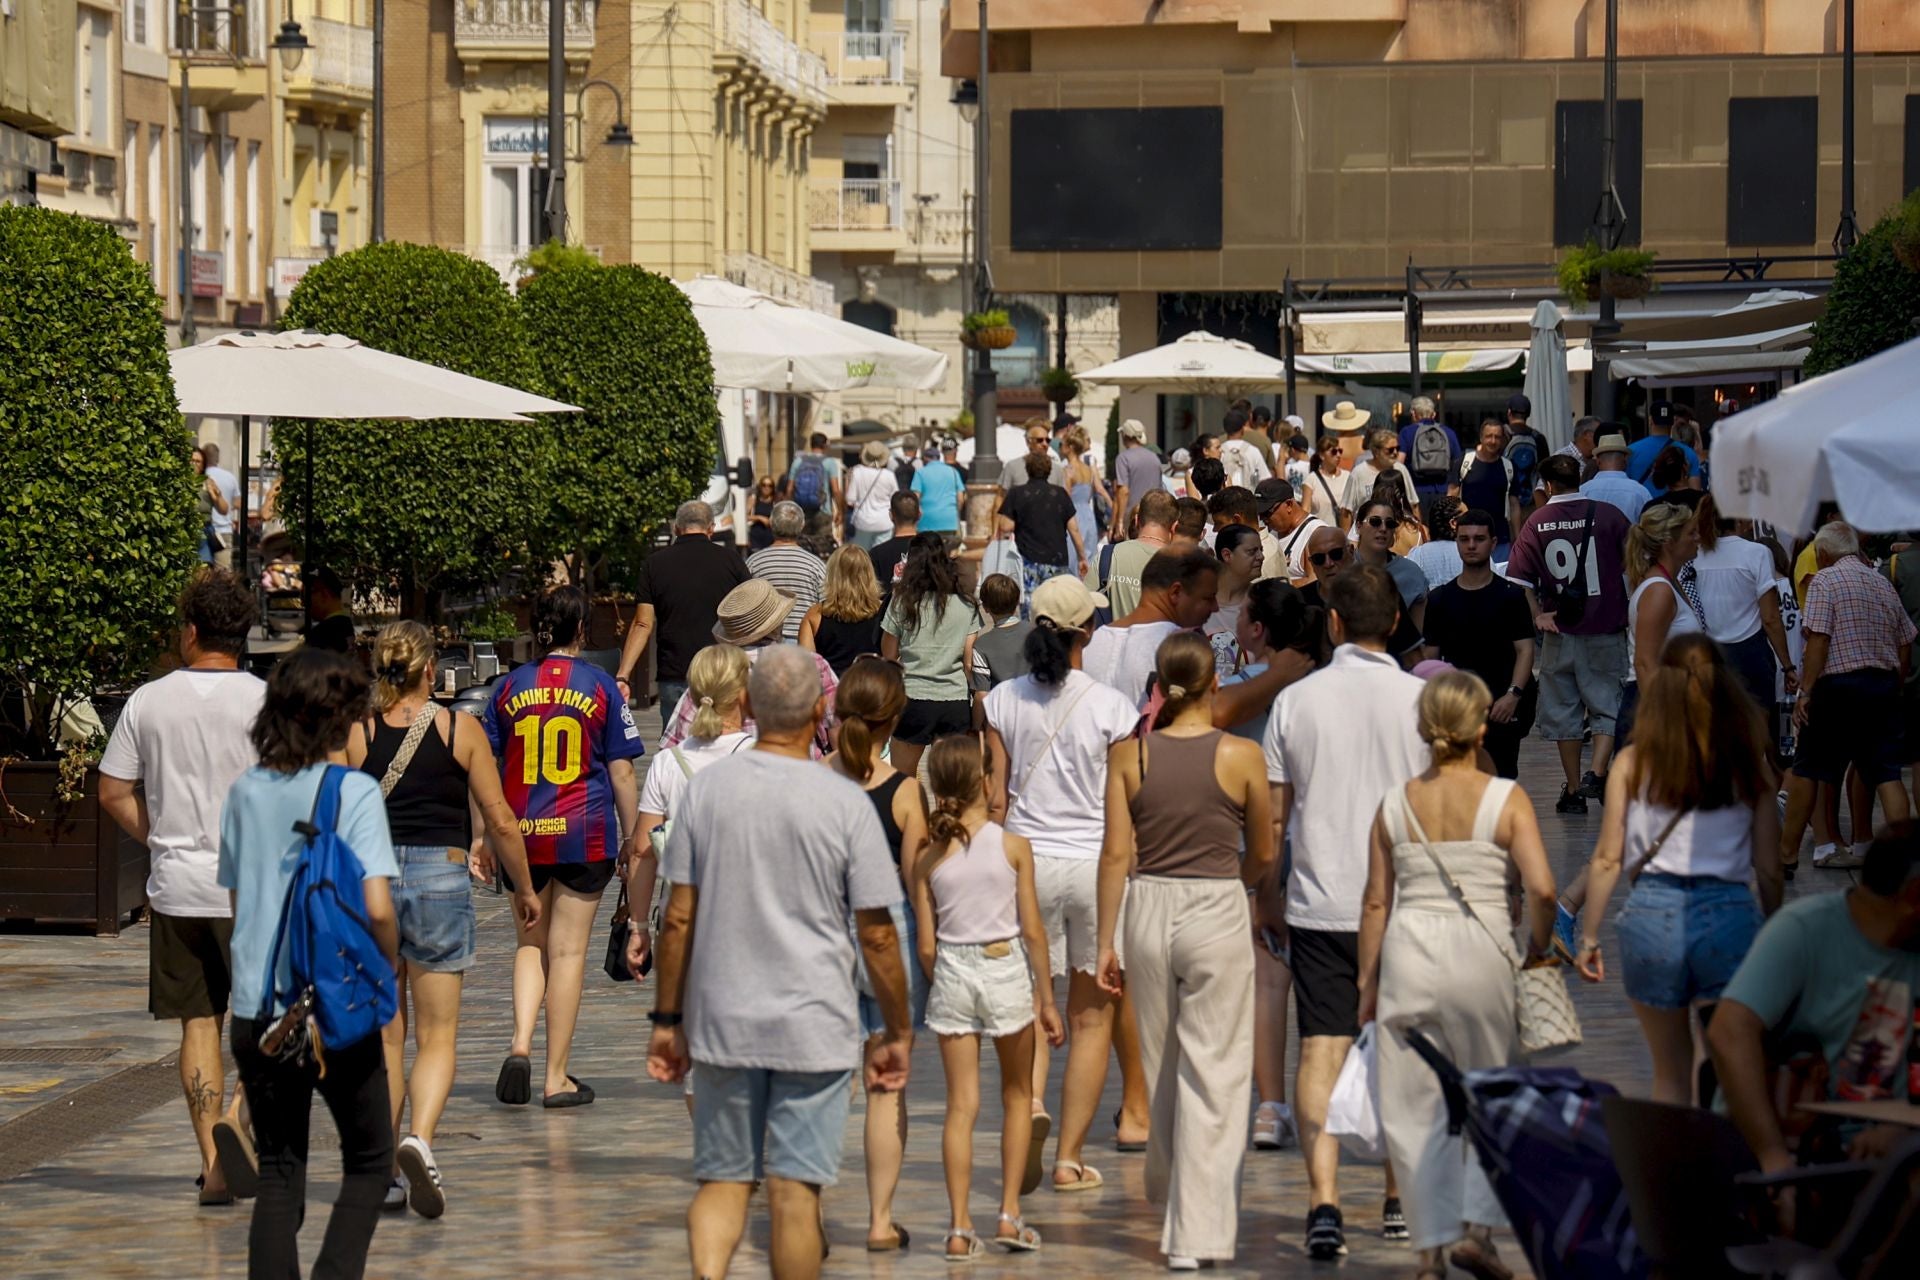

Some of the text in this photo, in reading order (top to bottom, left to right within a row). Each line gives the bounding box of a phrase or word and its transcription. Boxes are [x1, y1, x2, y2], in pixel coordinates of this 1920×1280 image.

[1537, 519, 1595, 533] LES JEUN
[1544, 535, 1601, 596] 91
[504, 687, 598, 718] LAMINE YAMAL
[514, 715, 582, 785] 10
[535, 817, 567, 826] UNHCR
[535, 825, 567, 833] ACNUR
